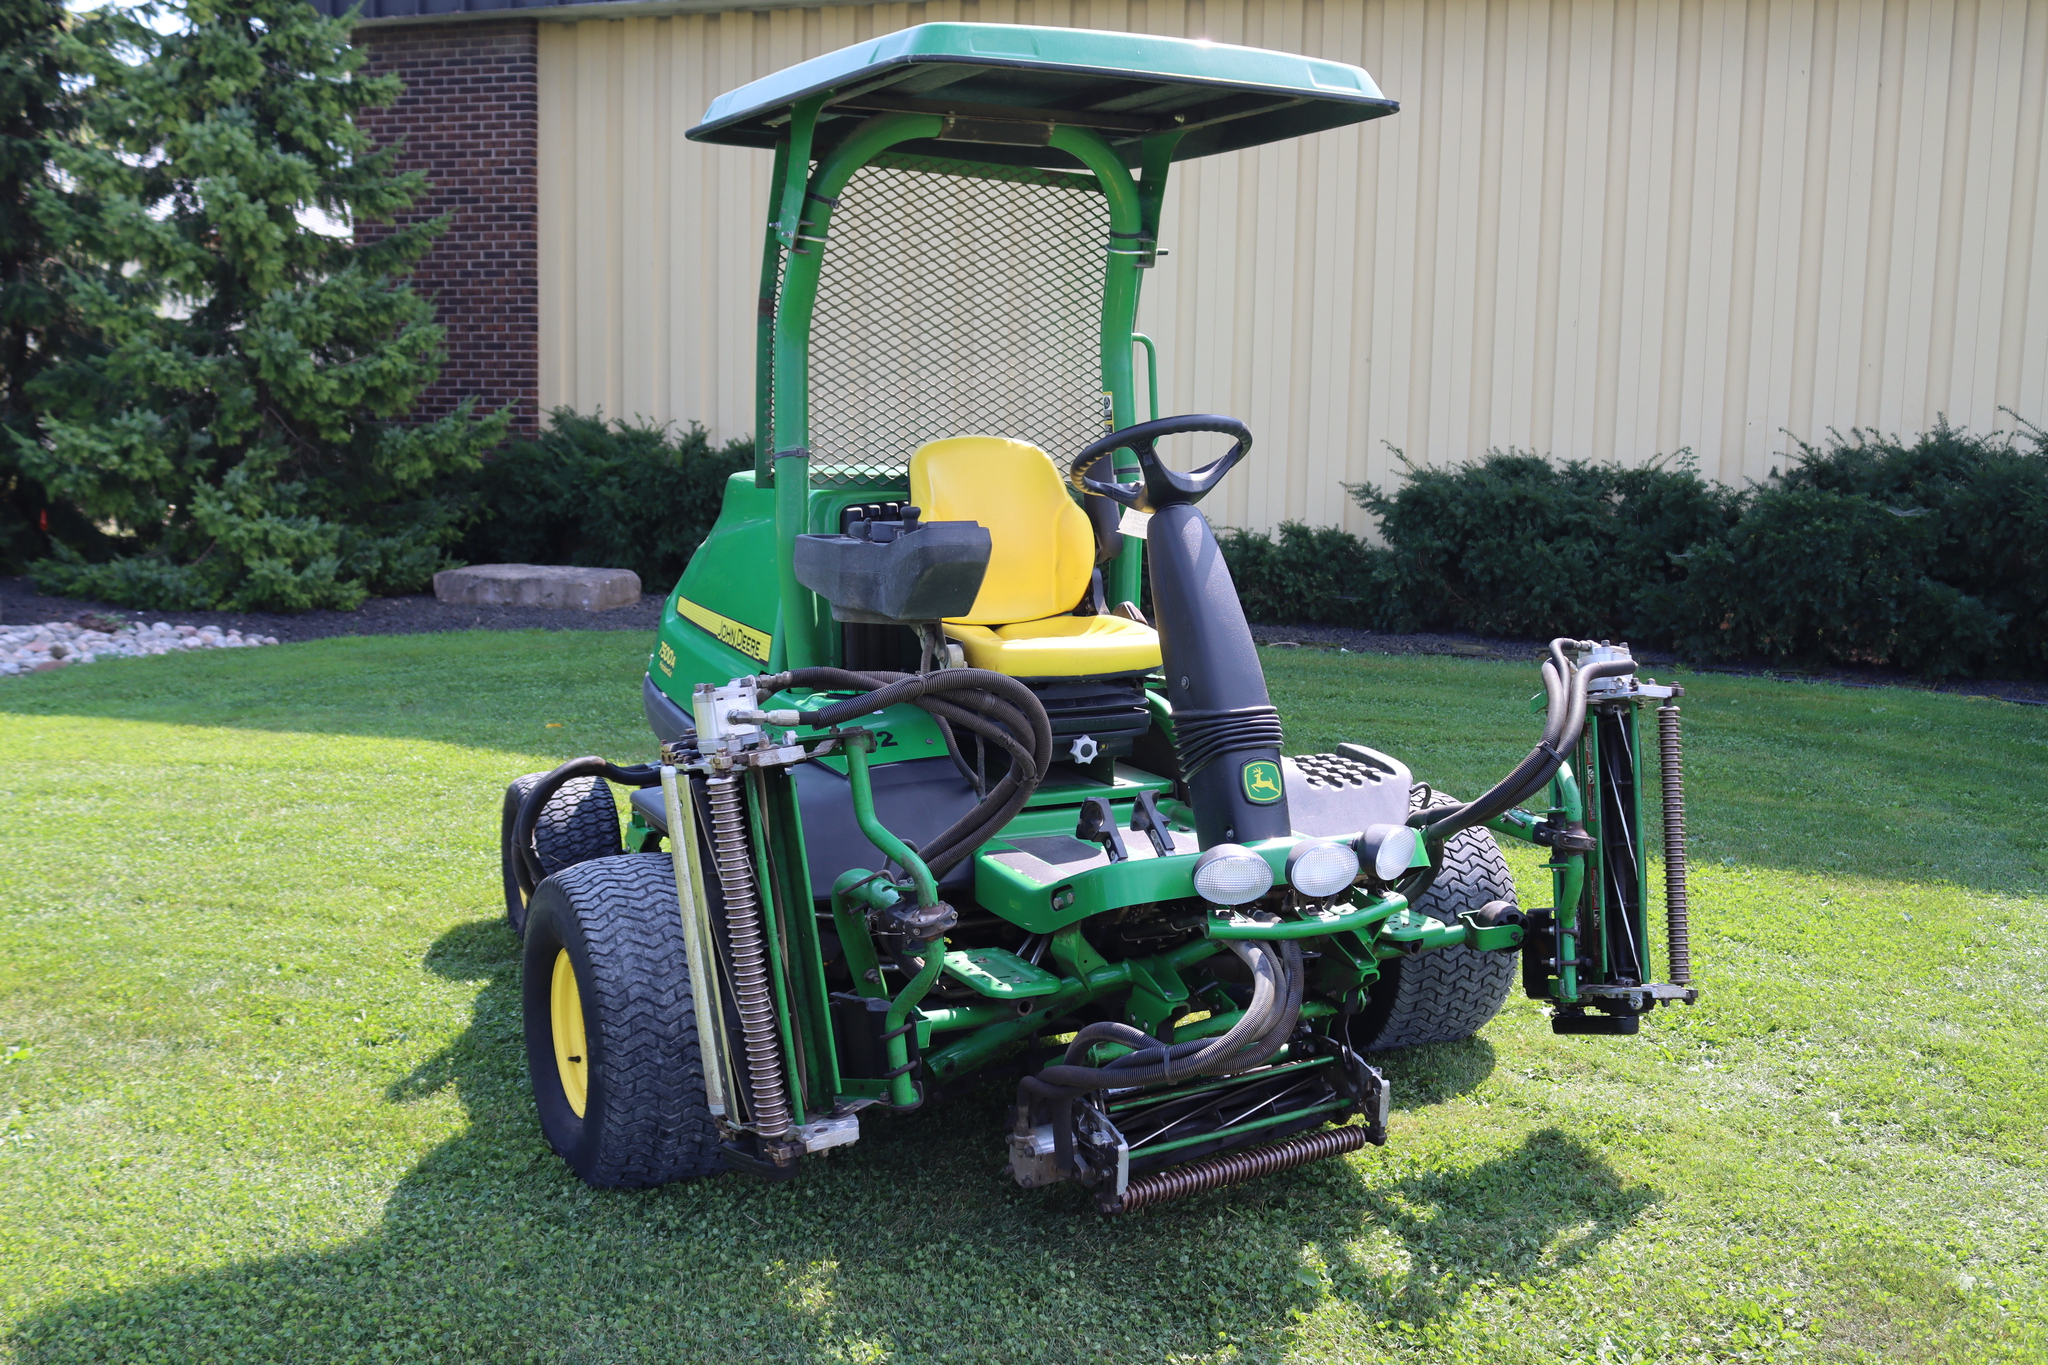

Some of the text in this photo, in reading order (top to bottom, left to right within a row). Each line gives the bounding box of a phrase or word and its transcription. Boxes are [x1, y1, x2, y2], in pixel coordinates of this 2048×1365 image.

[717, 619, 761, 658] JOHN DEERE
[658, 640, 676, 668] 7500A
[875, 731, 898, 748] 2
